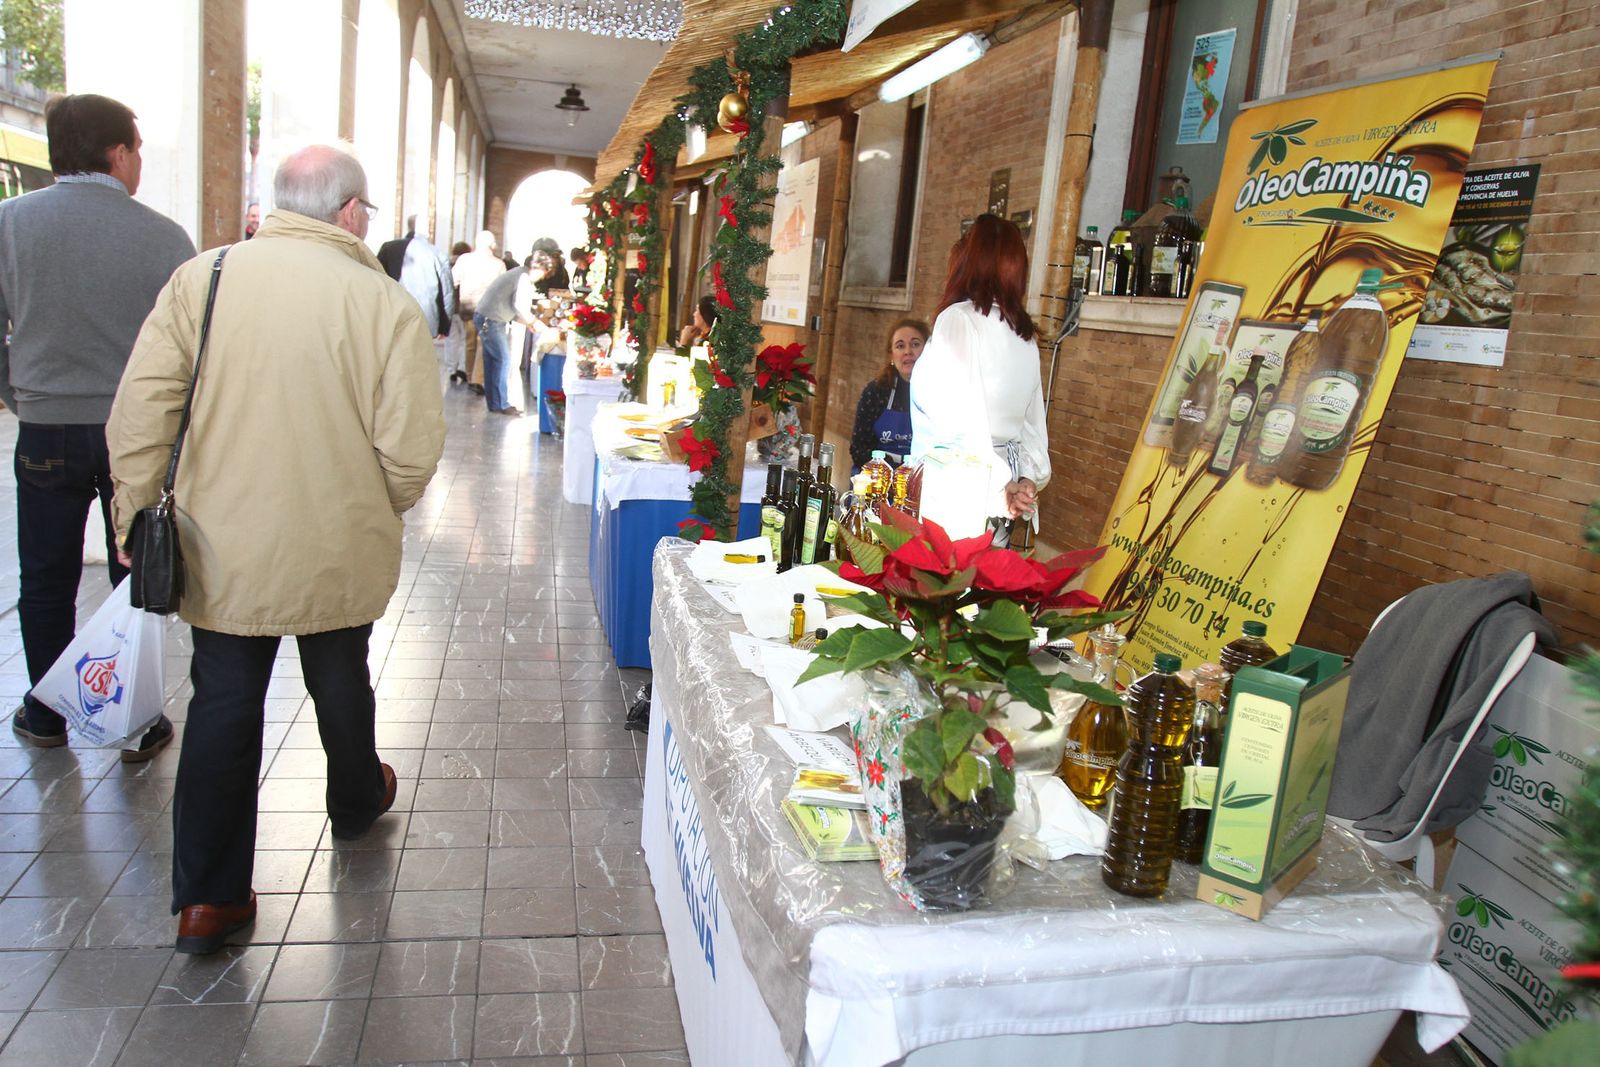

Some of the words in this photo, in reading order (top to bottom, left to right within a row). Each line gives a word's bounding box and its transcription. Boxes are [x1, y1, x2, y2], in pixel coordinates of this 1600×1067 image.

[1196, 37, 1211, 50] 525
[1234, 151, 1432, 210] OleoCampiña
[1470, 183, 1500, 191] CONSERVAS
[1484, 173, 1503, 181] ACEITE
[1460, 193, 1488, 201] PROVINCIA
[1496, 190, 1518, 198] HUELVA
[1111, 533, 1276, 618] www.oleocampiña.es
[1125, 571, 1160, 600] 959
[1156, 586, 1181, 613] 30
[1180, 597, 1204, 625] 70
[1203, 610, 1230, 639] 14
[1065, 750, 1118, 767] OleoCampiñ
[1489, 765, 1567, 817] OleoCa
[1518, 918, 1546, 941] ACEITE
[1544, 937, 1558, 950] DE
[1538, 945, 1567, 970] VIRG
[1448, 922, 1578, 1026] OleoCampiñ
